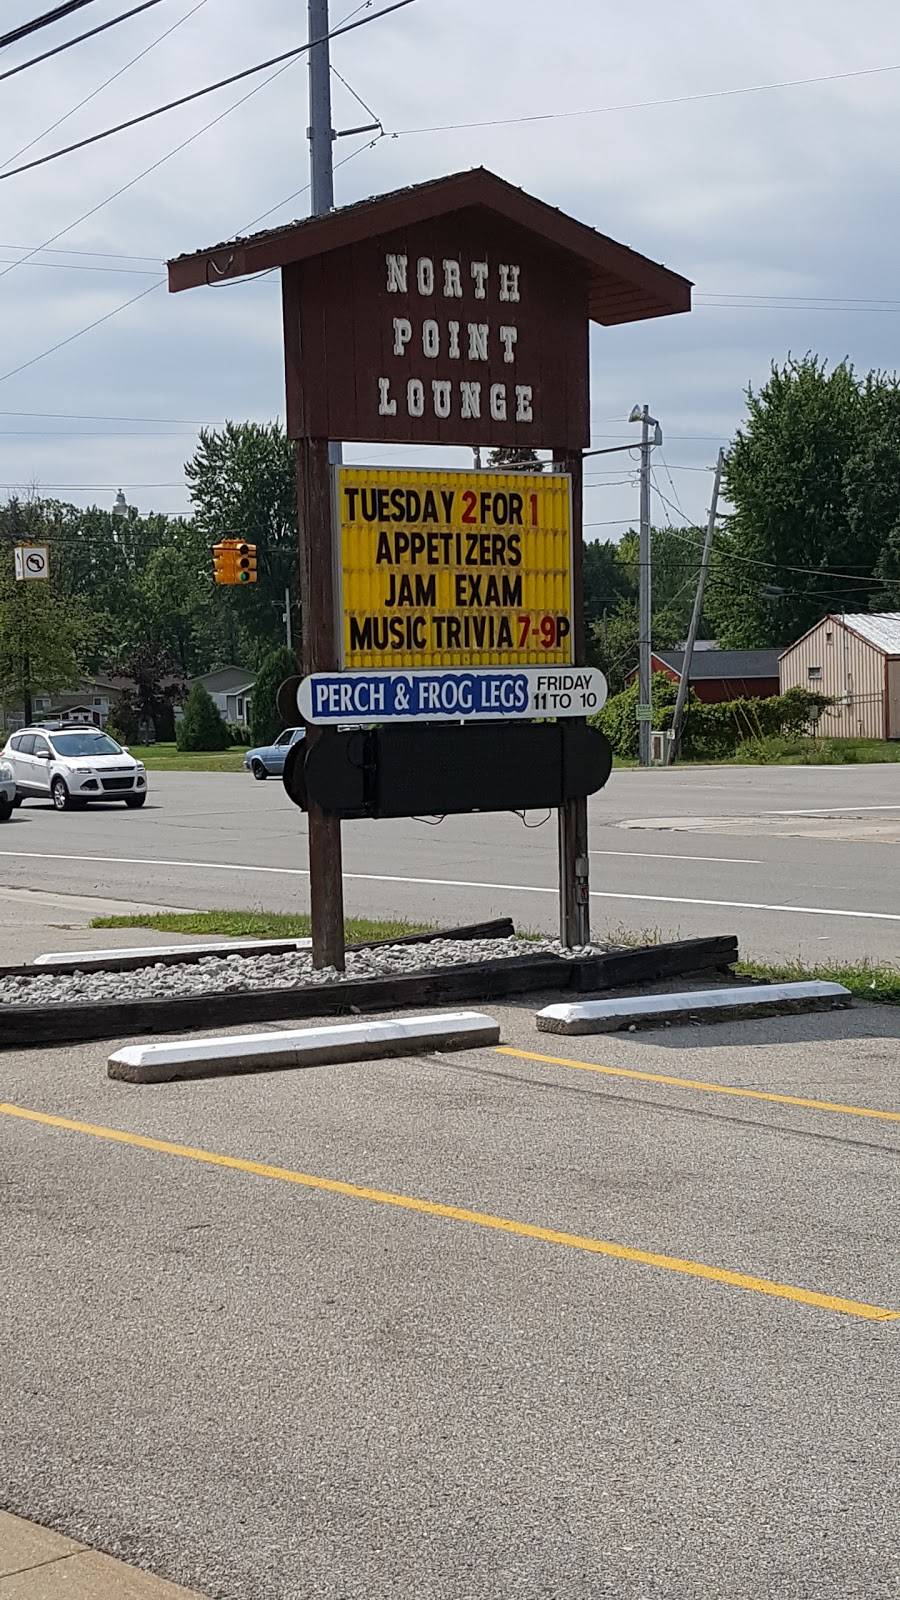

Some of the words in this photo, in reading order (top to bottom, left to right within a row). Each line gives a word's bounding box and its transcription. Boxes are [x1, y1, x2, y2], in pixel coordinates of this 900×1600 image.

[386, 254, 520, 303] NORTH
[393, 317, 518, 363] POINT
[378, 377, 533, 423] LOUNGE
[344, 488, 455, 524] TUESDAY
[461, 490, 477, 524] 2
[480, 492, 523, 526] FOR
[529, 494, 538, 527] 1
[376, 531, 522, 566] APPETIZERS
[384, 574, 436, 607] JAM
[455, 574, 523, 607] EXAM
[350, 616, 427, 650] MUSIC
[432, 616, 513, 649] TRIVIA
[316, 682, 385, 712] PERCH
[395, 680, 410, 710] &
[418, 679, 473, 709] FROG
[480, 678, 525, 708] LEGS
[537, 674, 592, 691] FRIDAY
[533, 692, 547, 710] 11
[551, 694, 572, 709] TO
[579, 692, 597, 708] 10
